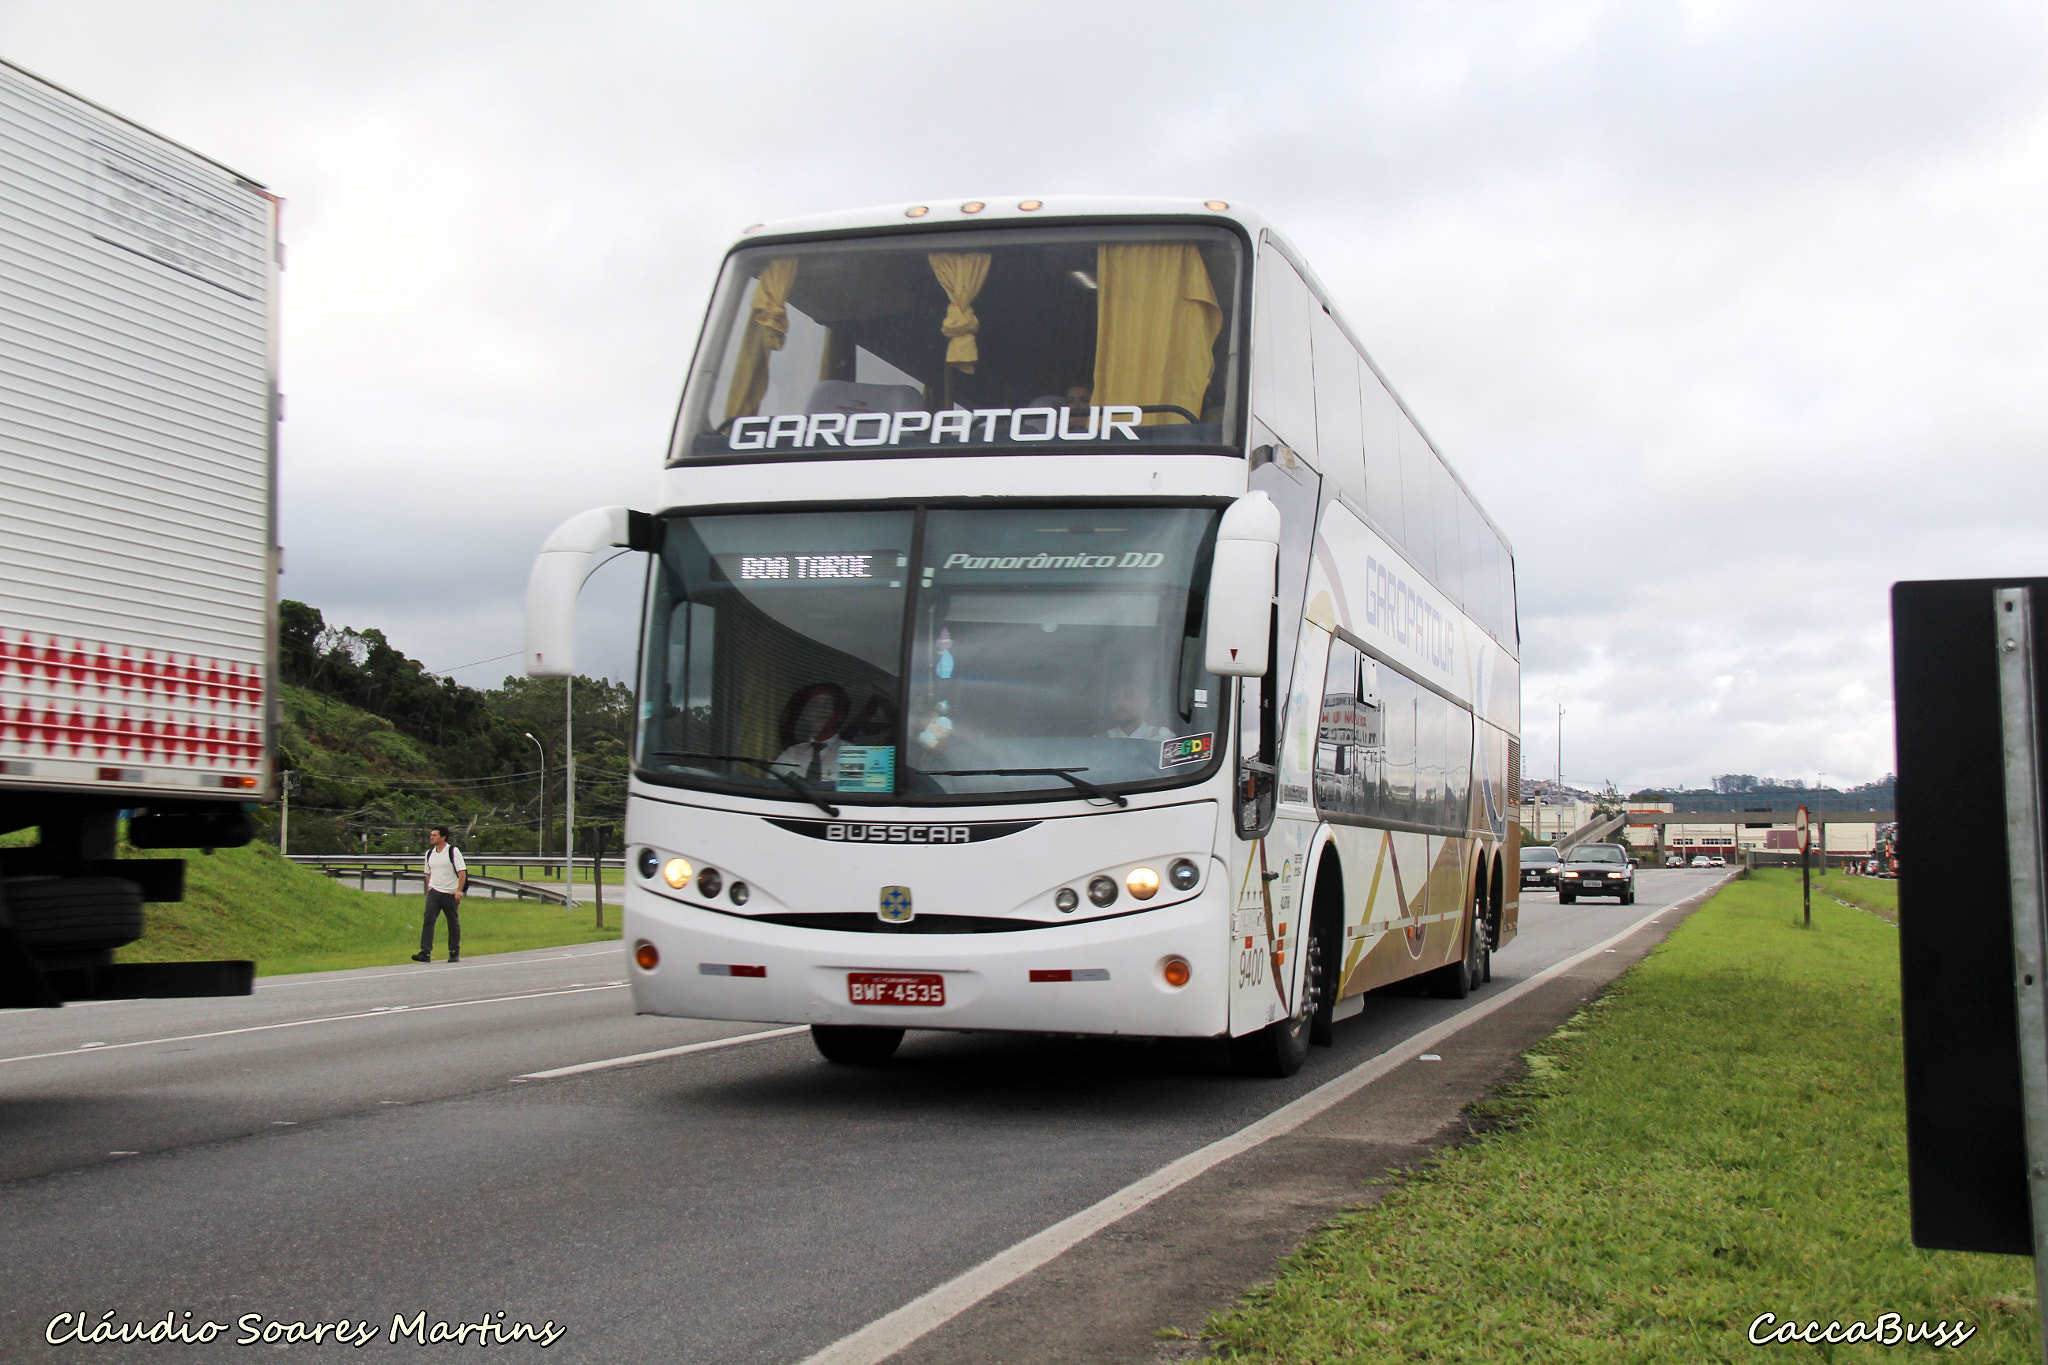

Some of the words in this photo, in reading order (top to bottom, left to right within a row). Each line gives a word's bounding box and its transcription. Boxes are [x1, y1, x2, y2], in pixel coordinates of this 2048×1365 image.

[729, 405, 1142, 450] GAROPATOUR
[741, 557, 789, 579] BOA
[794, 555, 873, 578] TARDE
[943, 552, 1116, 569] Panorâmico
[1117, 552, 1165, 568] DD
[1366, 555, 1454, 677] GAROPATOUR
[826, 824, 970, 842] BUSSCAR
[1239, 948, 1264, 989] 9400
